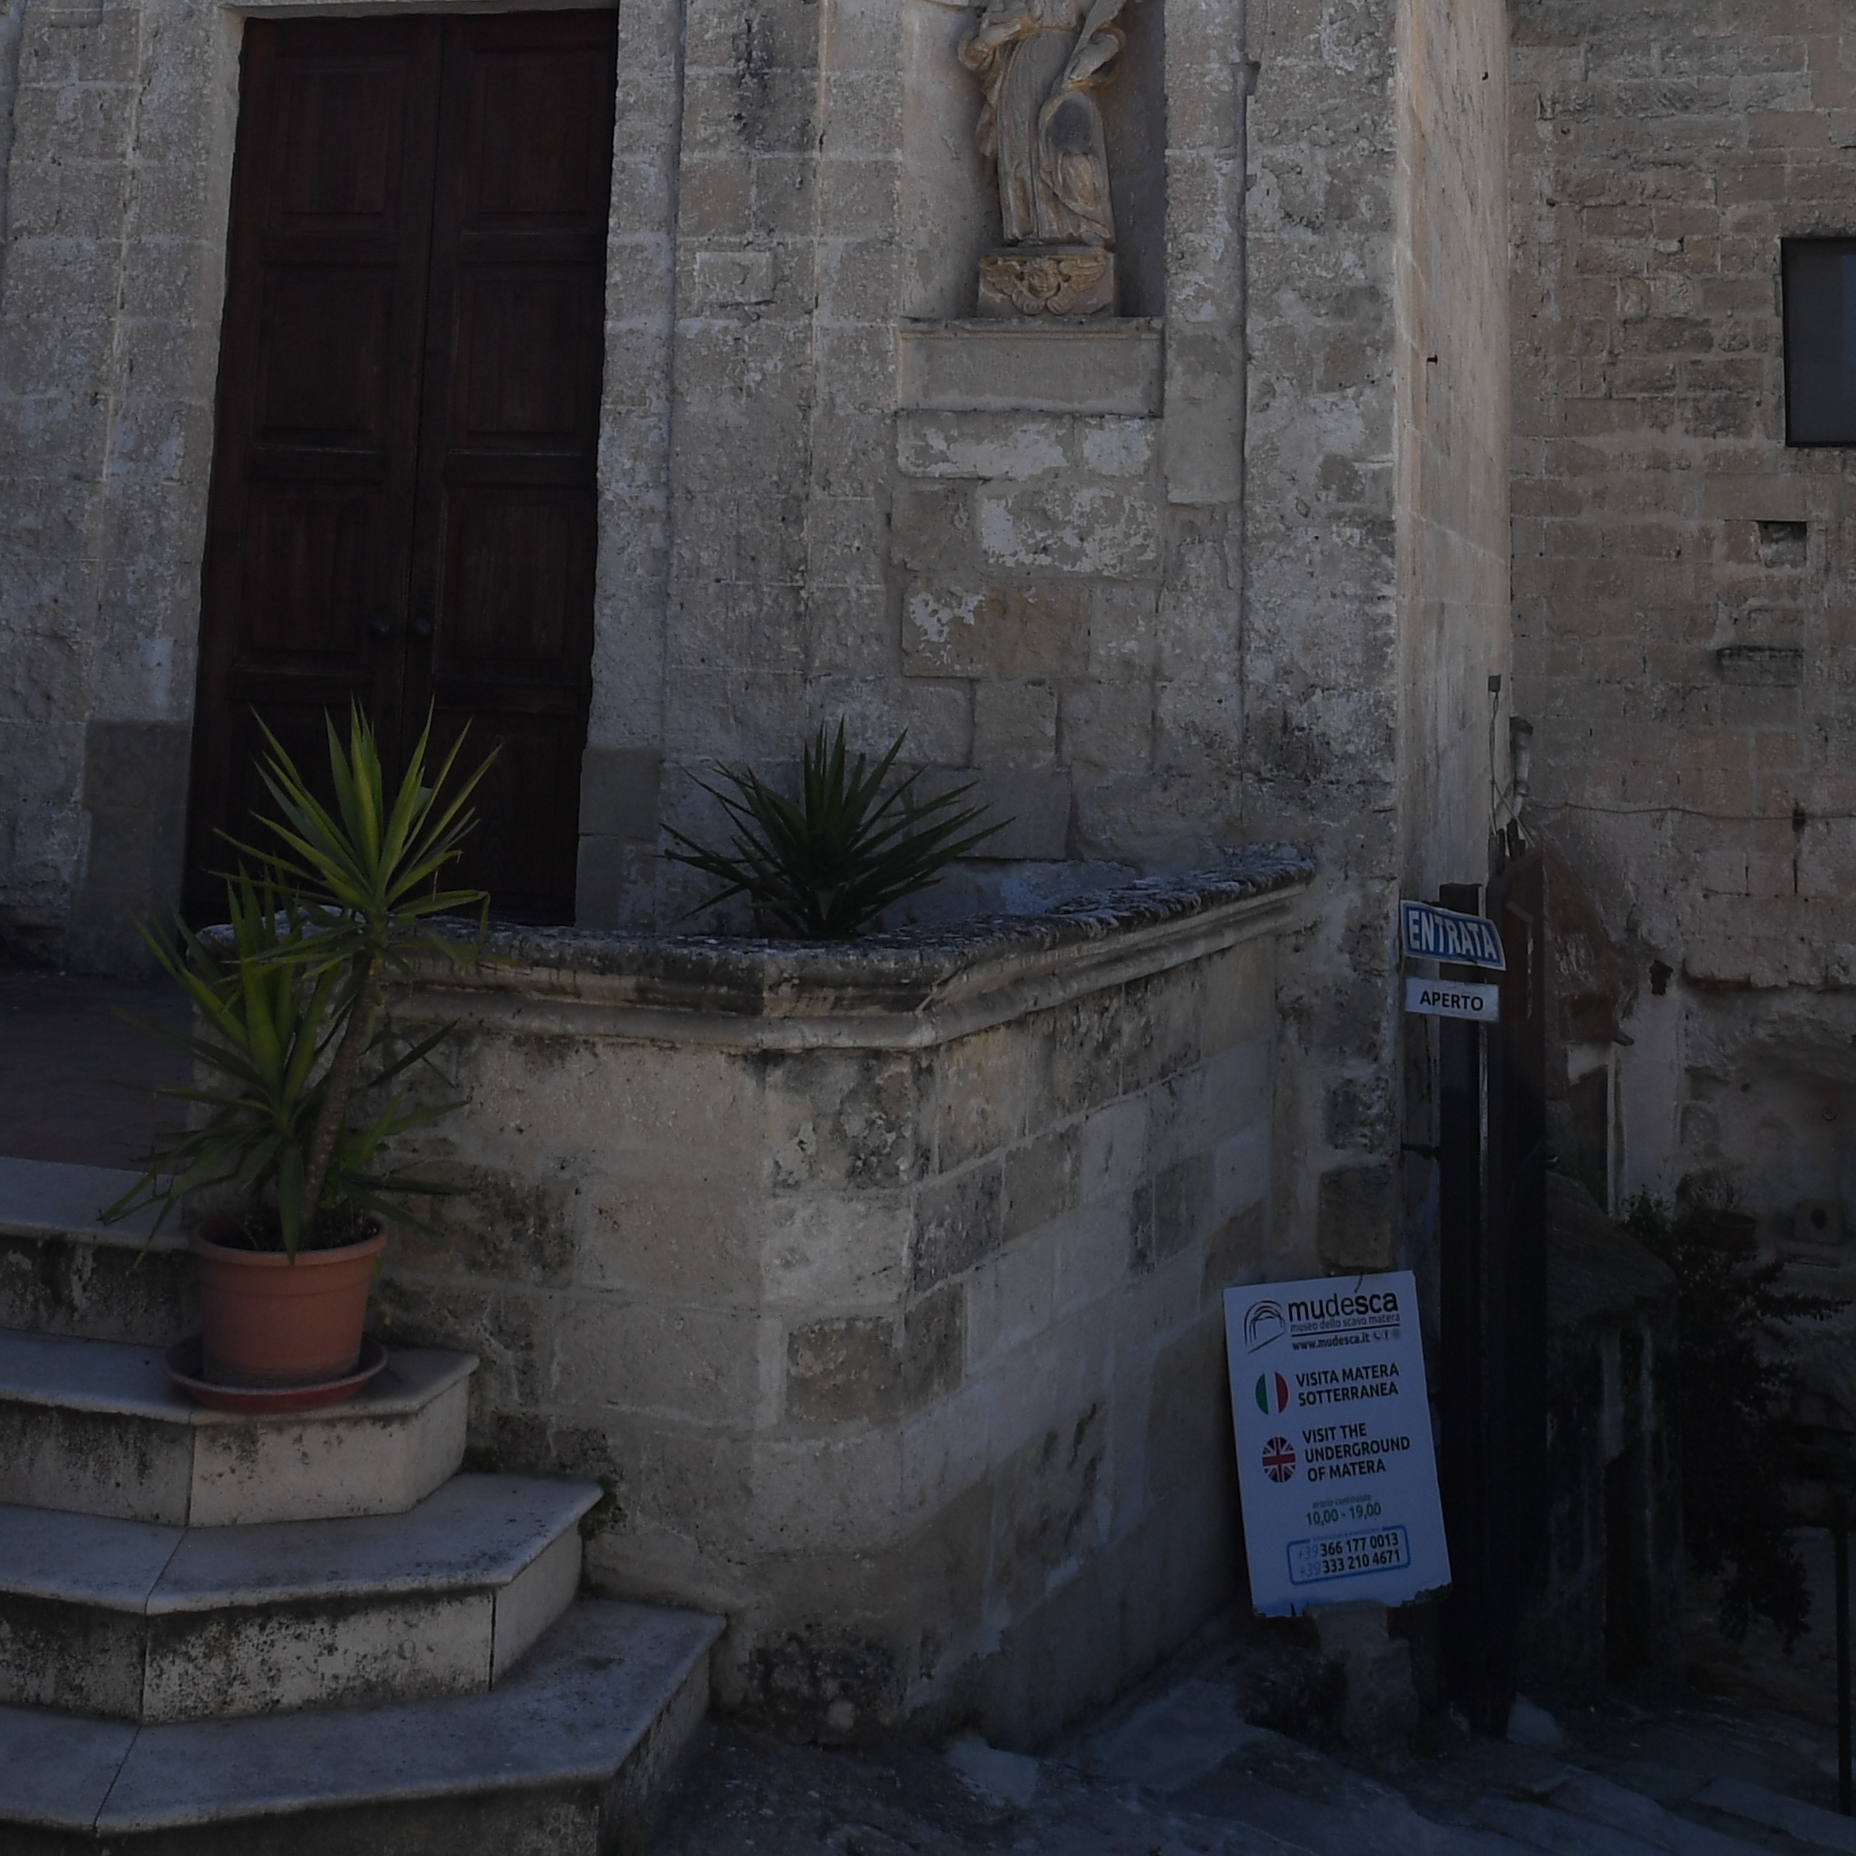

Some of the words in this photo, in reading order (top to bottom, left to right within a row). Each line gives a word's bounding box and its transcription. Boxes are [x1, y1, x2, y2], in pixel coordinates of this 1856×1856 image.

[1408, 910, 1499, 960] ENTRATA
[1419, 990, 1484, 1012] APERTO
[1288, 1293, 1399, 1322] mudesca
[1290, 1322, 1318, 1333] museo
[1320, 1318, 1341, 1329] dello
[1343, 1315, 1367, 1327] scavo
[1368, 1312, 1401, 1324] matera
[1292, 1331, 1371, 1351] www.mudesca.it
[1296, 1370, 1339, 1387] VISITA
[1342, 1363, 1400, 1382] MATERA
[1298, 1382, 1399, 1406] SOTTERRANEA
[1302, 1426, 1337, 1443] VISIT
[1340, 1423, 1367, 1438] THE
[1305, 1436, 1411, 1463] UNDERGROUND
[1307, 1467, 1325, 1482] OF
[1329, 1459, 1386, 1480] MATERA
[1306, 1509, 1339, 1526] 10,00
[1349, 1502, 1382, 1520] 19,00
[1298, 1545, 1319, 1560] +39
[1320, 1541, 1343, 1557] 366
[1346, 1537, 1366, 1553] 177
[1370, 1532, 1399, 1549] 0013
[1300, 1562, 1321, 1577] +39
[1322, 1558, 1345, 1574] 333
[1348, 1554, 1370, 1570] 210
[1372, 1549, 1400, 1565] 4671
